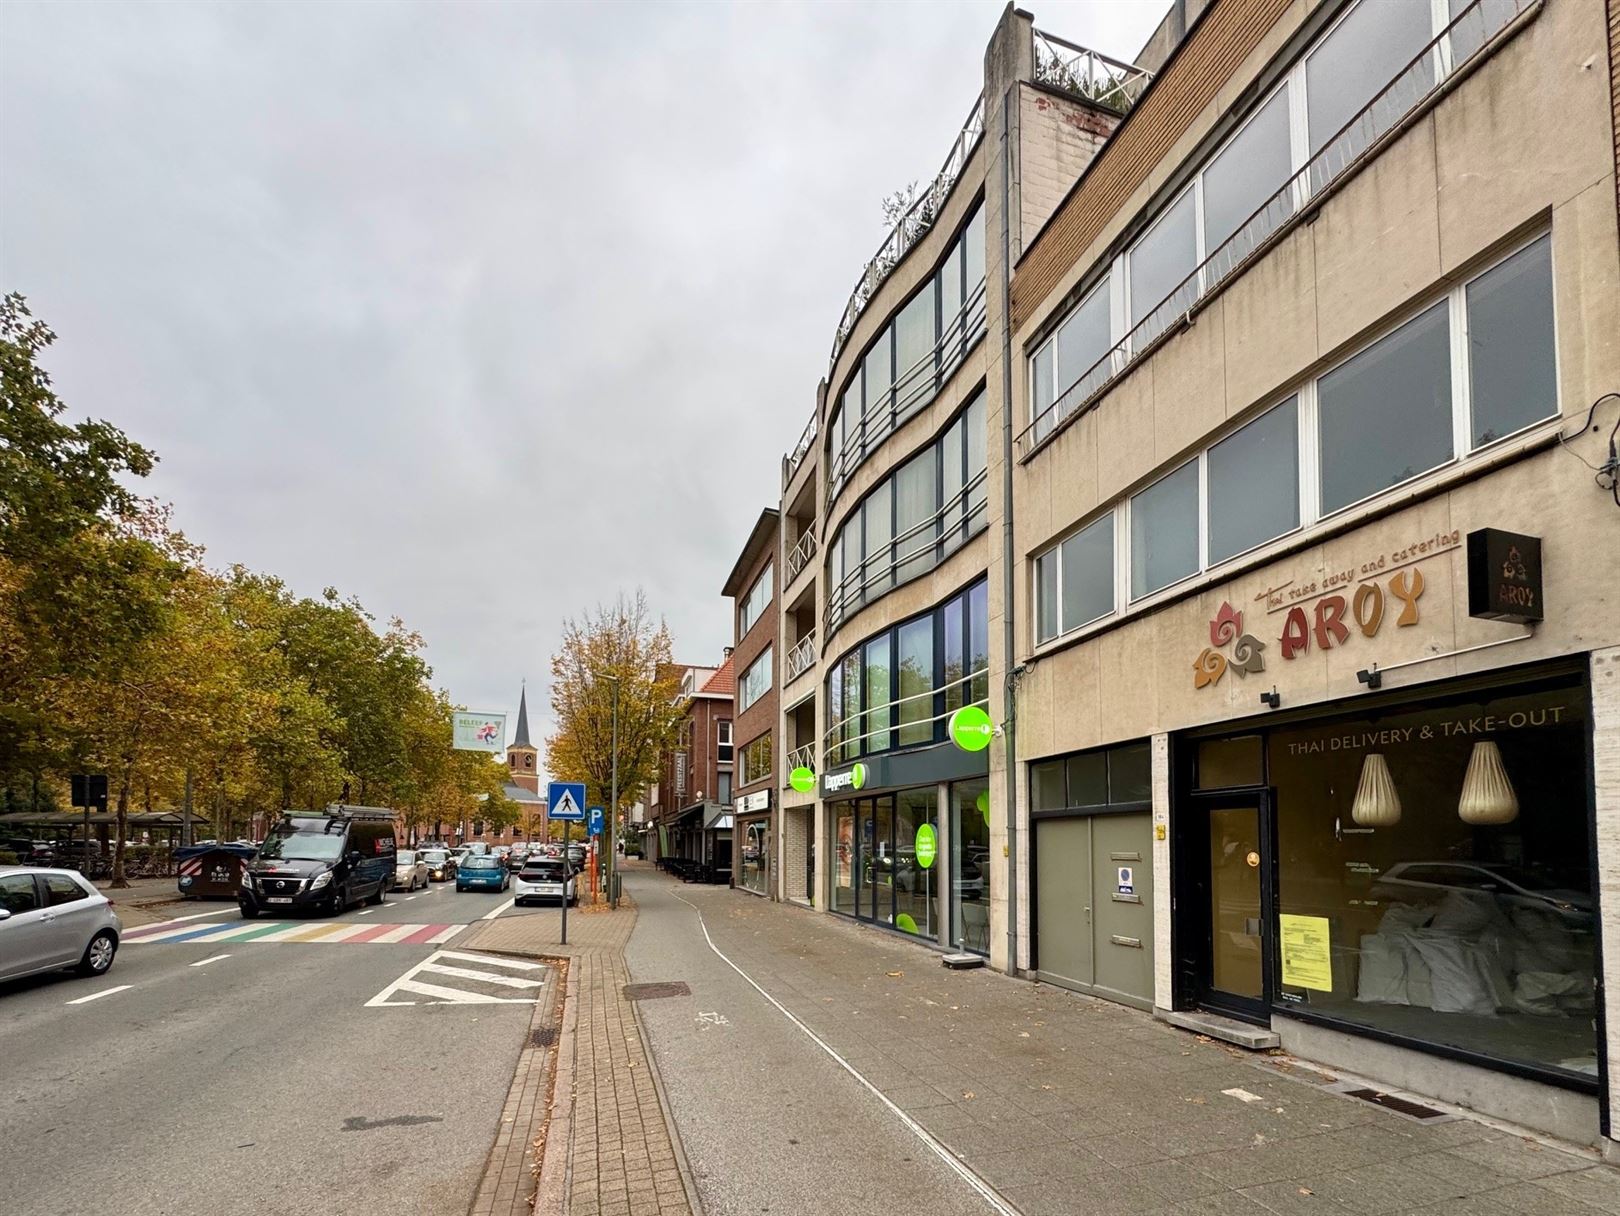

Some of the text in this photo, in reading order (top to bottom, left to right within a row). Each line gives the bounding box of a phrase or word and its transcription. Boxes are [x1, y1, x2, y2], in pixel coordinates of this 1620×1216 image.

[1289, 582, 1317, 600] take
[1322, 568, 1355, 589] away
[1361, 555, 1386, 574] and
[1392, 529, 1461, 563] catering
[1277, 567, 1426, 660] AROY
[1498, 583, 1534, 607] AROY
[1288, 706, 1566, 755] THAI DELIVERY & TAKE-OUT
[591, 809, 602, 824] P
